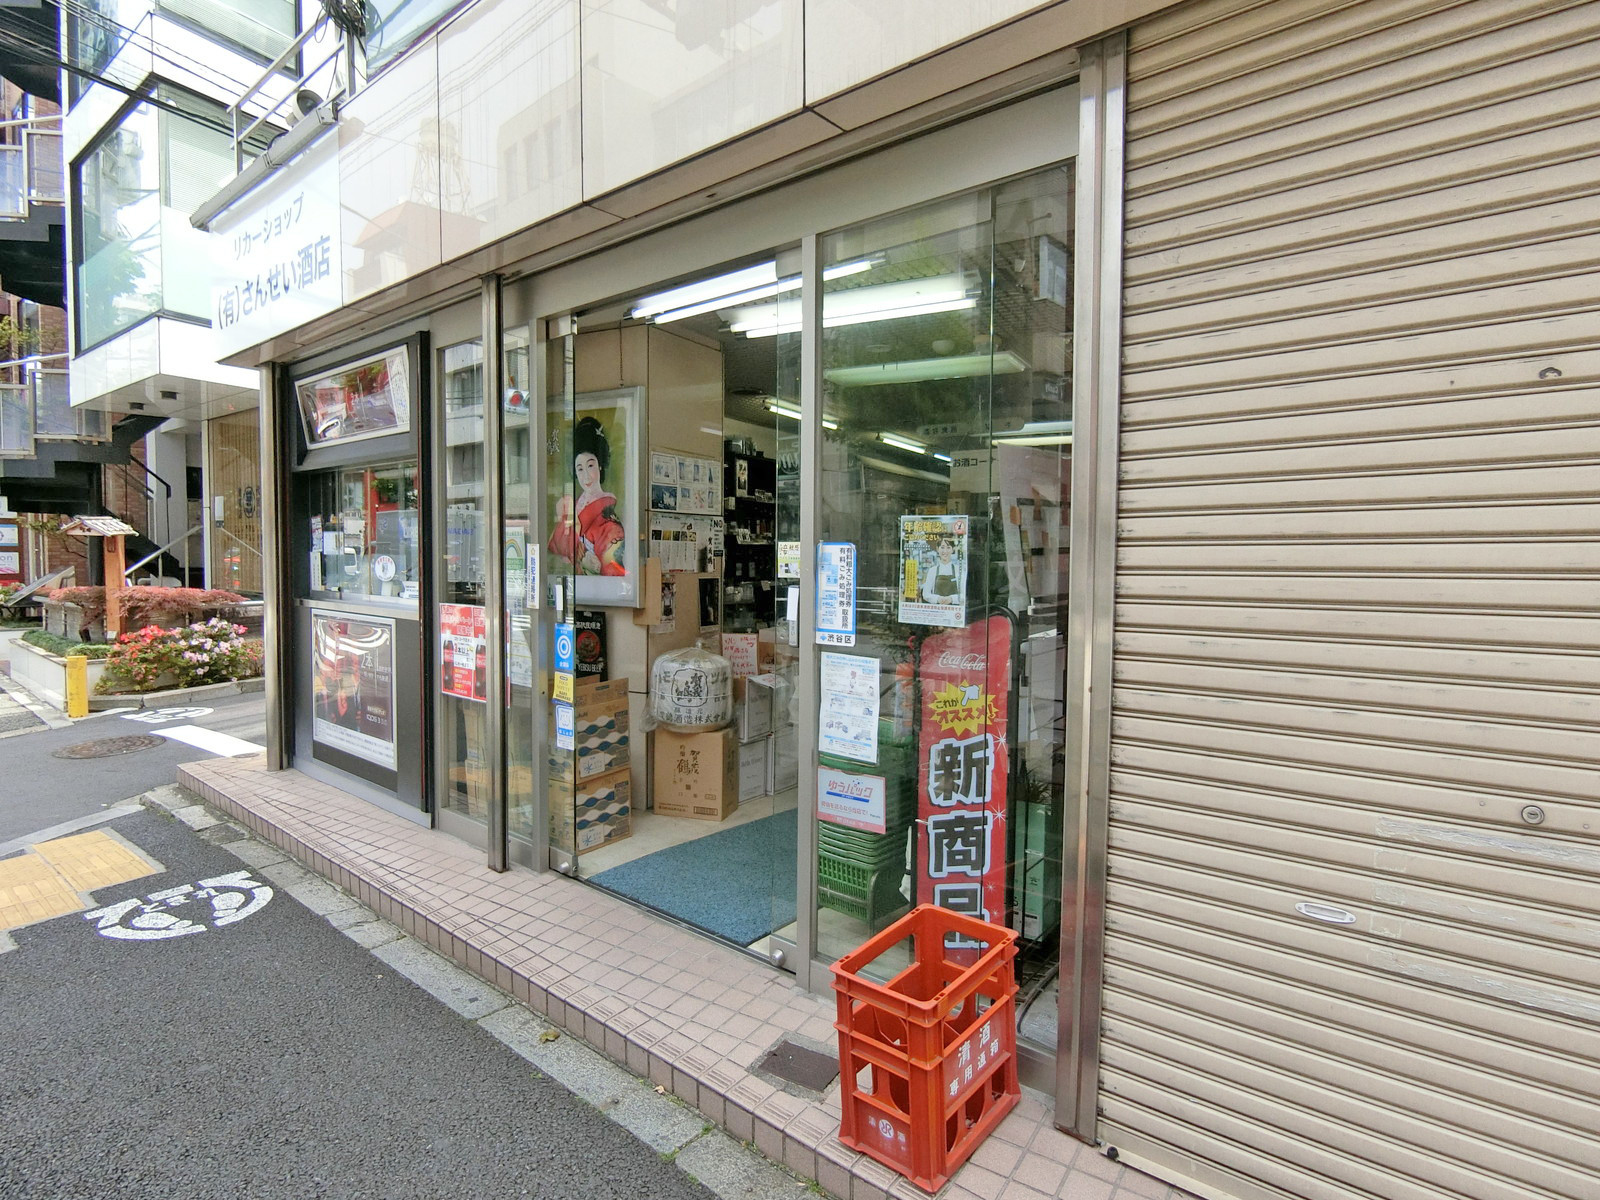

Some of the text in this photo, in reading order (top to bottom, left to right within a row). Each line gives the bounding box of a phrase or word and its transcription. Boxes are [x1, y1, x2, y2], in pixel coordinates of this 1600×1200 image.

[234, 191, 304, 260] リカーショップ
[218, 235, 331, 330] (有)さんせい酒店
[838, 547, 846, 608] 有料ごみ処理券
[827, 633, 852, 644] 渋谷区
[936, 697, 959, 709] これが
[828, 779, 873, 798] ゆうパック
